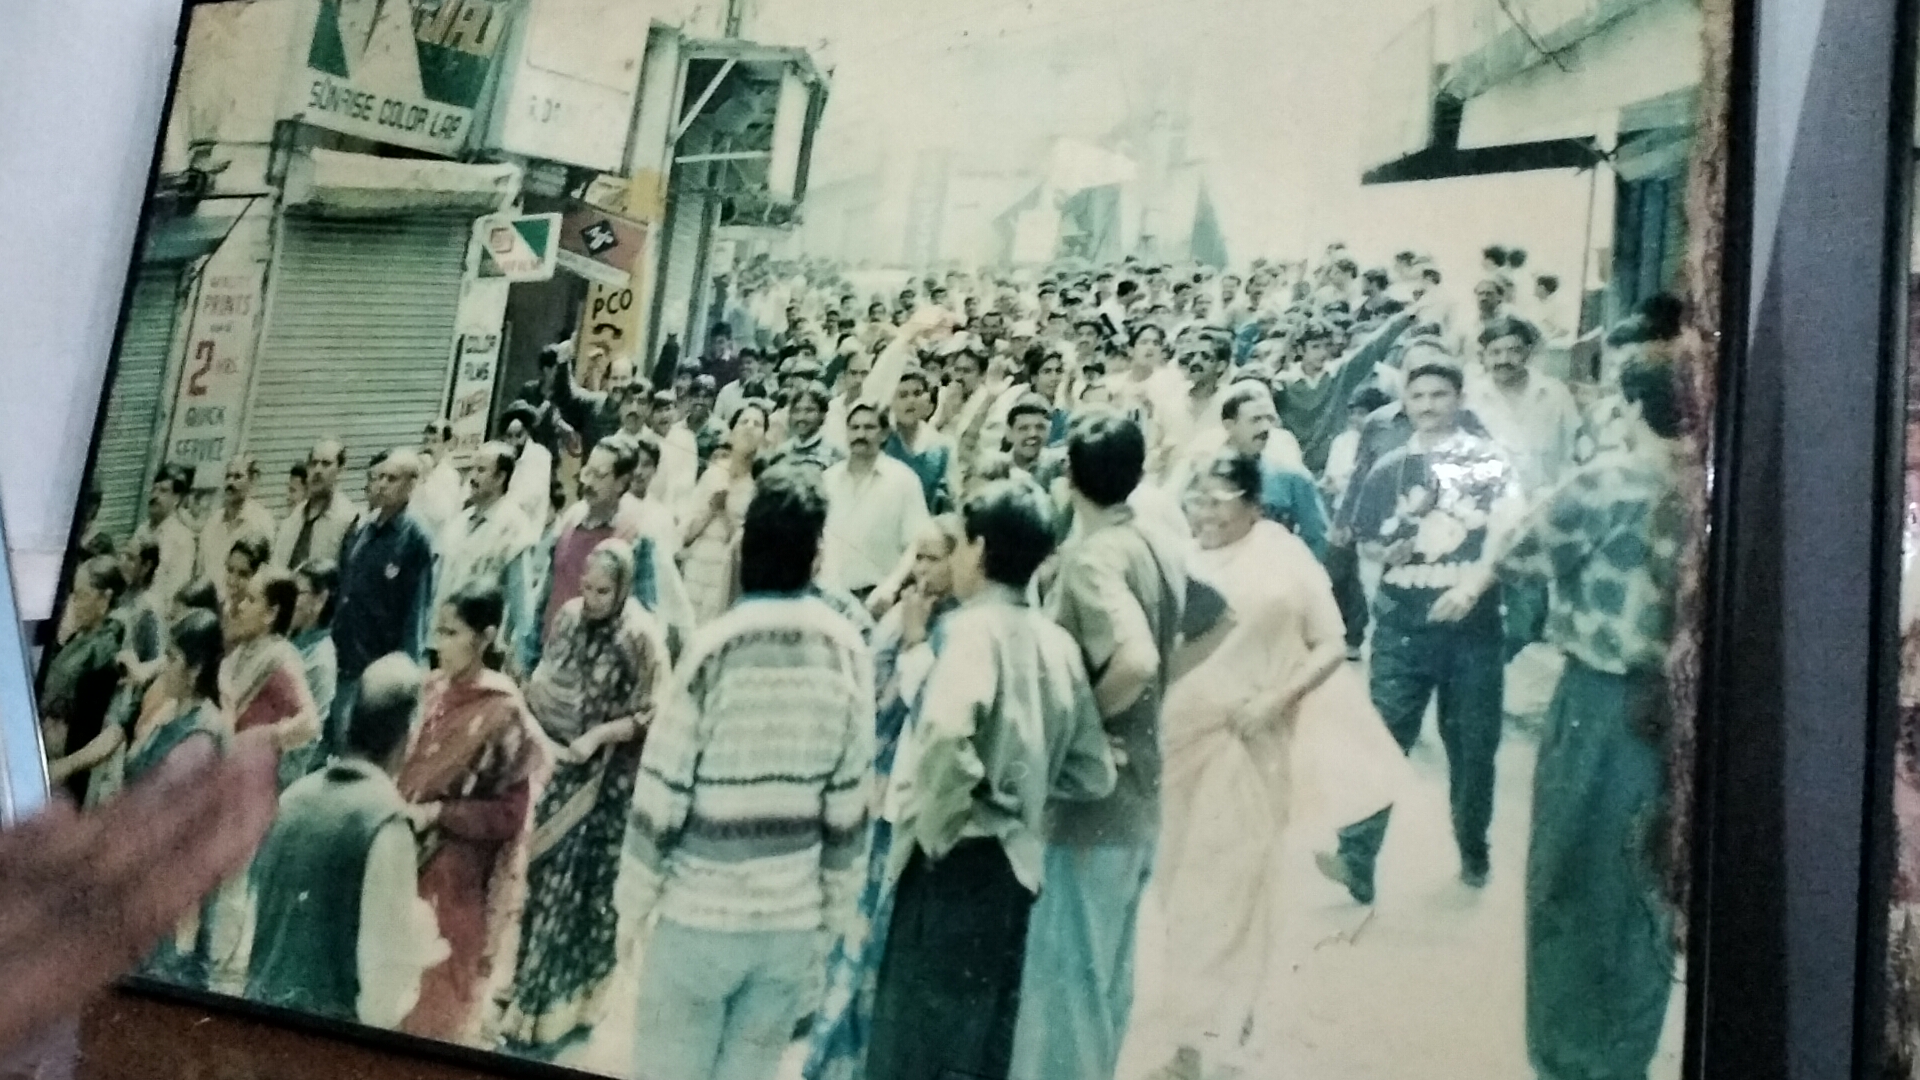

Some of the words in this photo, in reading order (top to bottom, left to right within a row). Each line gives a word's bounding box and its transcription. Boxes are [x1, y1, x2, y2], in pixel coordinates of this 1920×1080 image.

[308, 79, 375, 121] SUNRISE
[378, 98, 429, 131] COLOR
[203, 294, 252, 317] PRINTS
[592, 289, 633, 321] PCO
[188, 340, 216, 397] 2
[185, 406, 227, 428] QUICK
[175, 436, 226, 463] SERVICE
